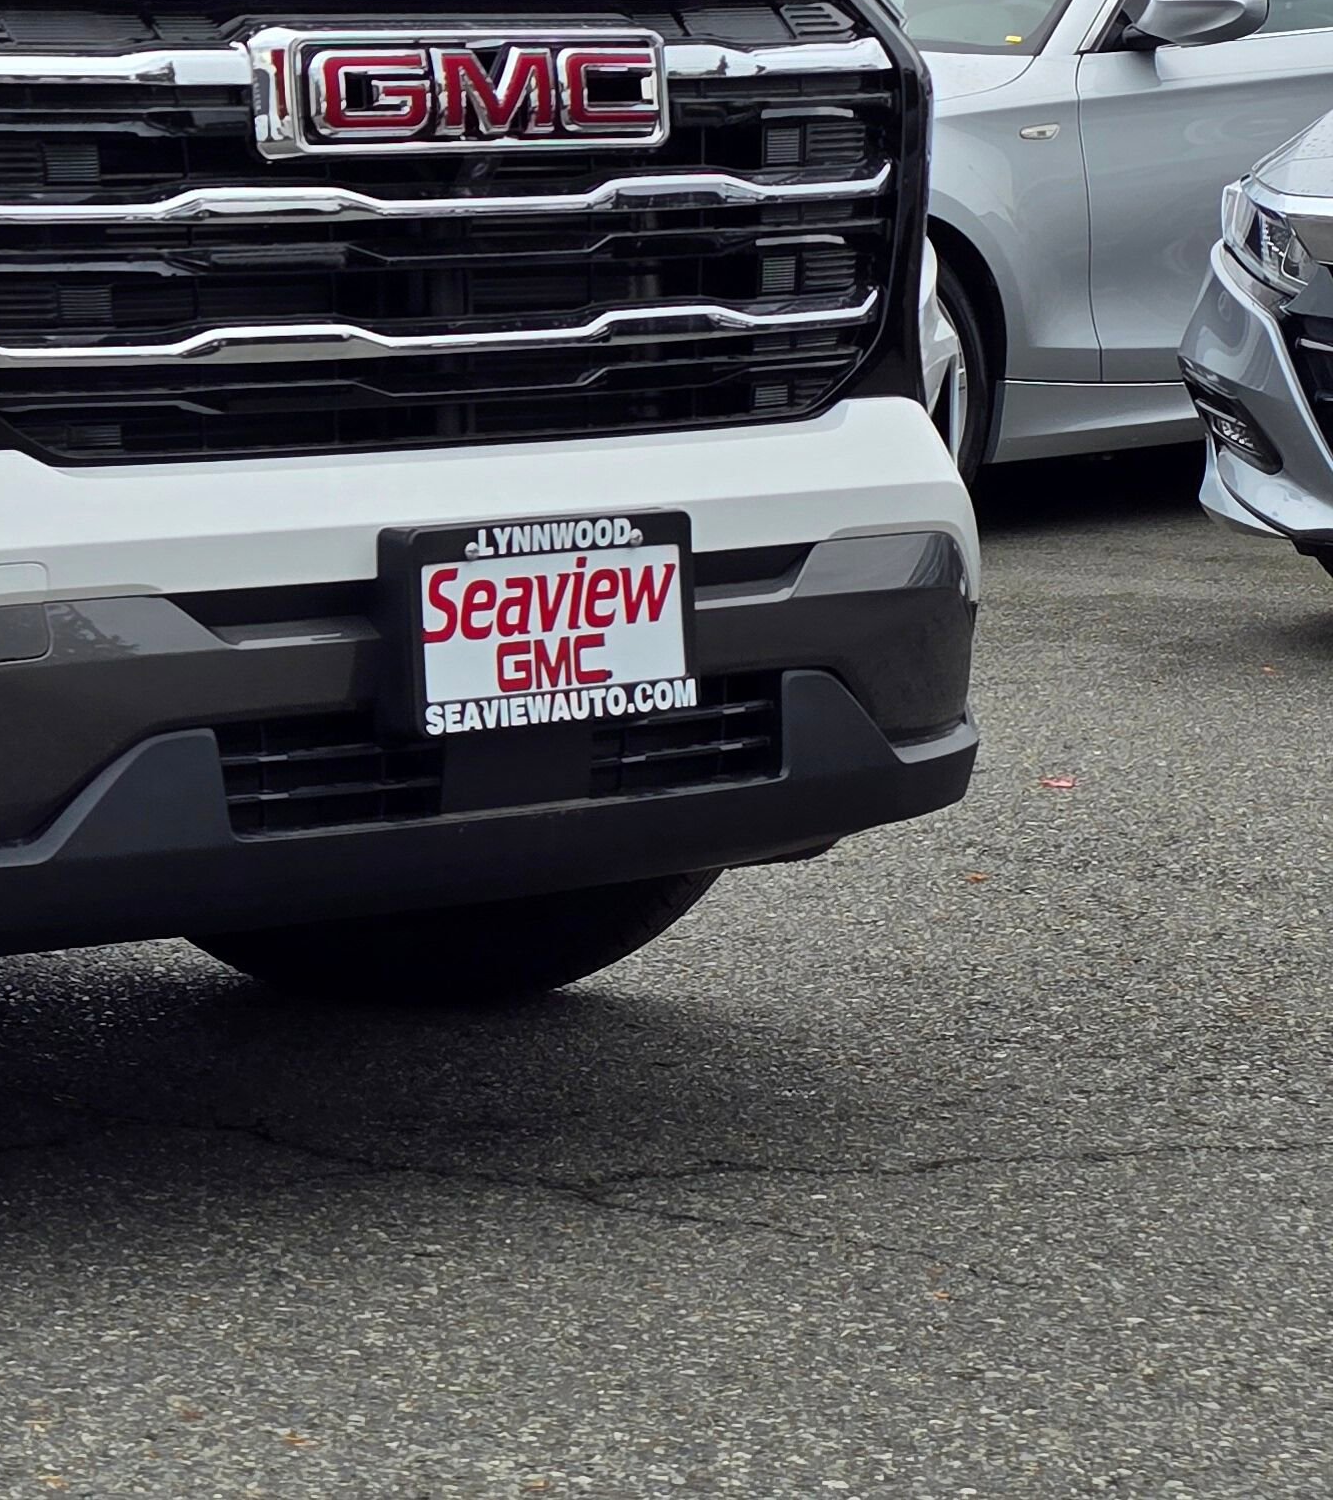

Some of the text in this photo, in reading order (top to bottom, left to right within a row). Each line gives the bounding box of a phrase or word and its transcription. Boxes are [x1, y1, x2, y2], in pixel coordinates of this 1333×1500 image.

[308, 46, 660, 137] GMC
[477, 517, 632, 557] LYNNWOOD
[421, 555, 677, 644] Seaview
[496, 632, 613, 693] GMC
[424, 677, 698, 736] SEAVIEWAUTO.COM
